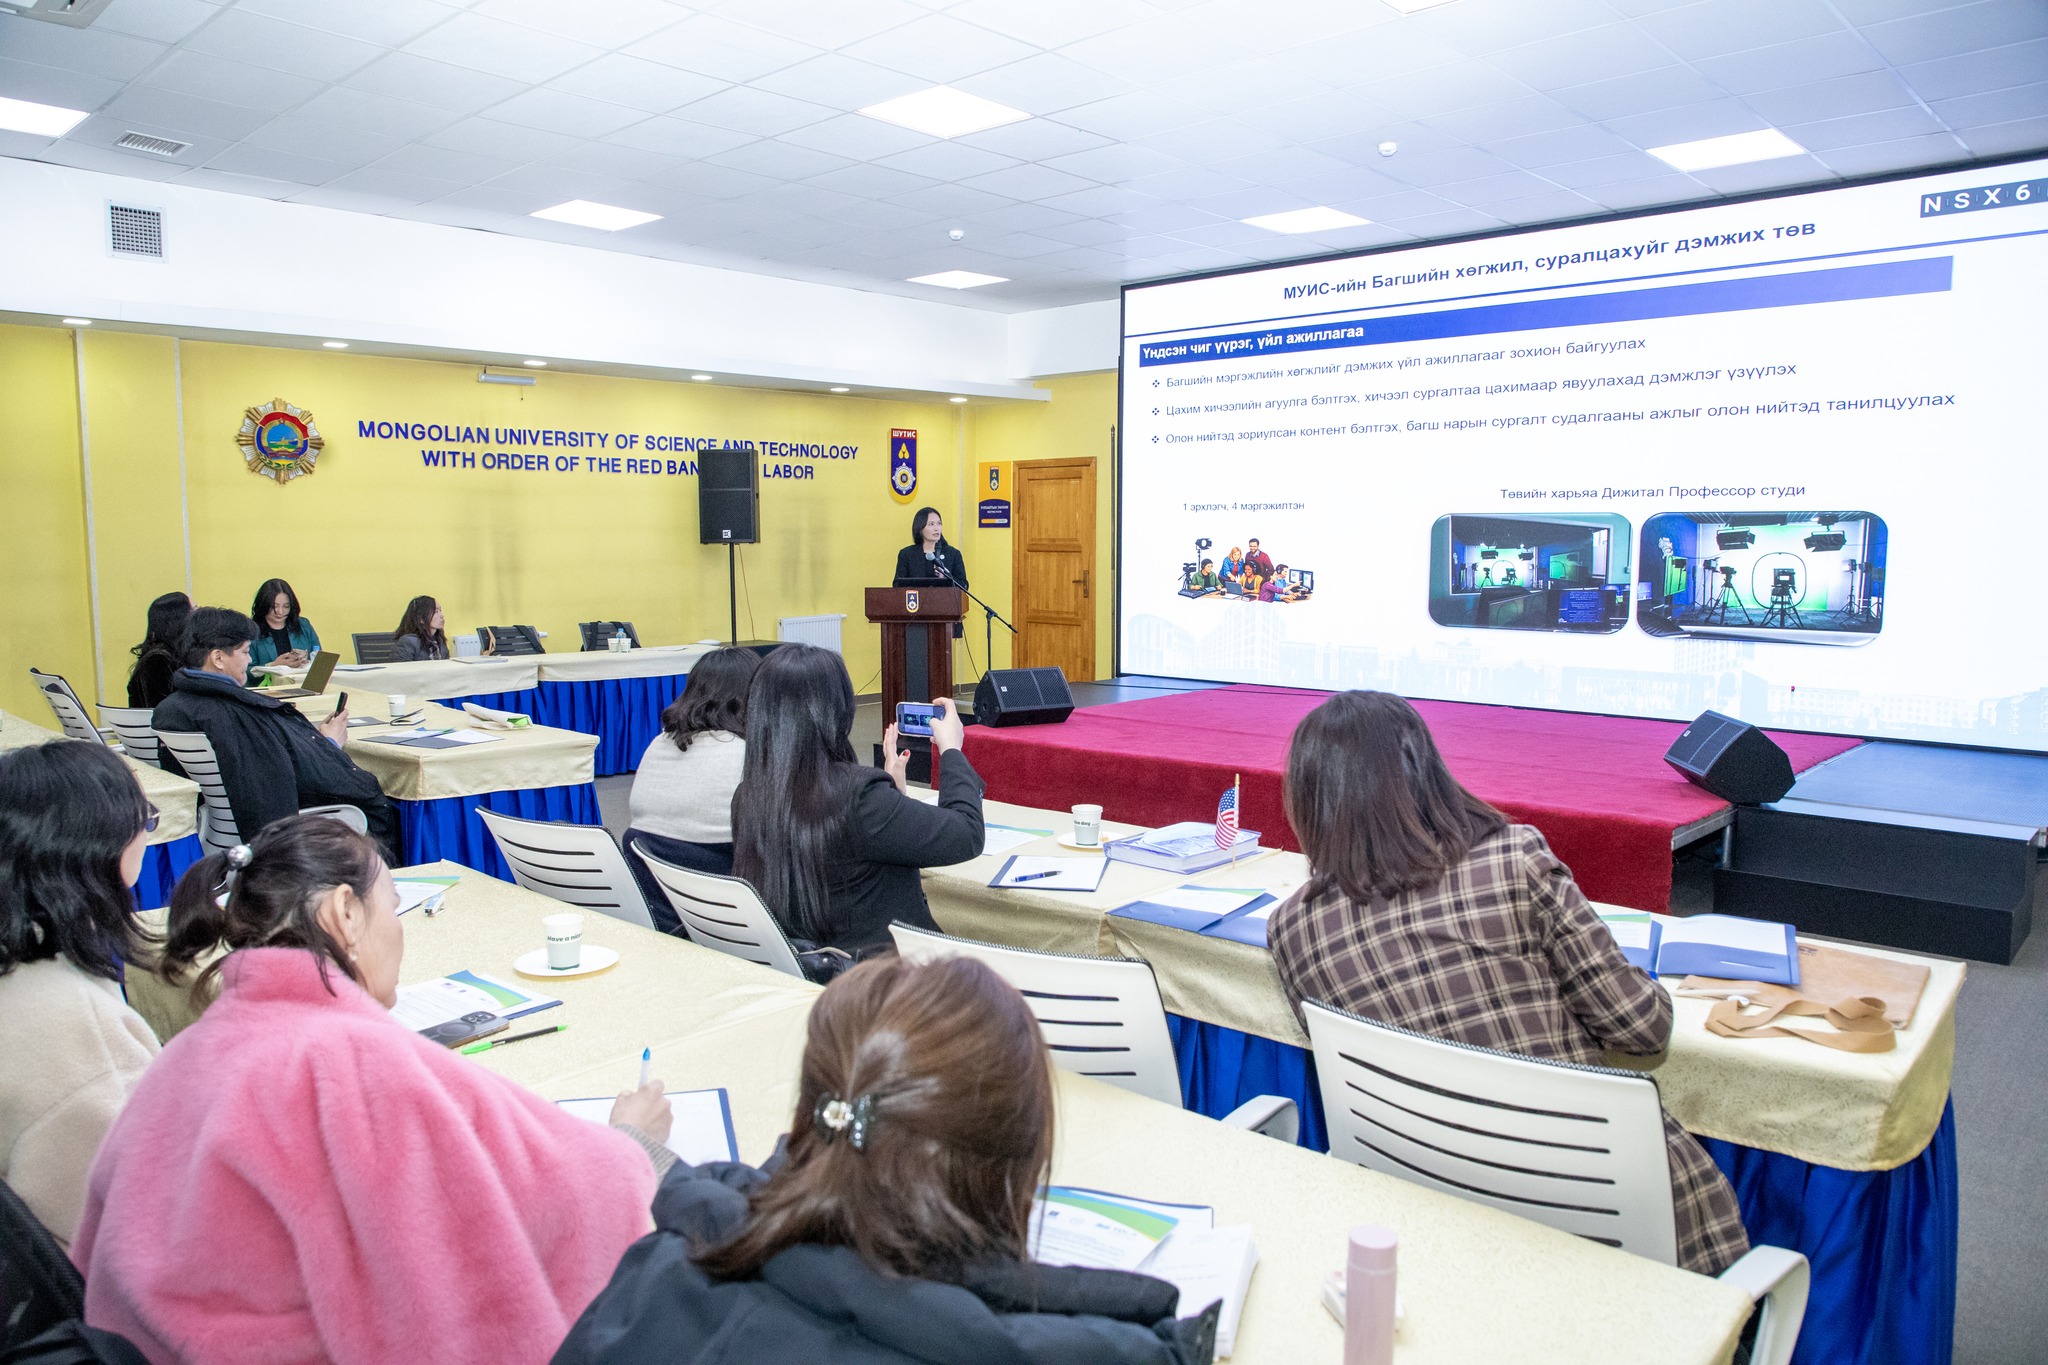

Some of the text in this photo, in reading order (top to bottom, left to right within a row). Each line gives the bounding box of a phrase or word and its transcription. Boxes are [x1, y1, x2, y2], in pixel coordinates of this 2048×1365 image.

[1283, 223, 1816, 300] МУИС-ийн Багшийн хөгжил, суралцахуйг дэмжих төв
[1142, 326, 1364, 359] Үндсэн чиг үүрэг, үйл ажиллагаа
[1166, 339, 1646, 388] Багшийн мэргэжлийн хөгжлийг дэмжих үйл ажиллагааг зохион байгуулах
[1166, 364, 1797, 417] Цахим хичээлийн агуулга бэлтгэх, хичээл сургалтаа цахимаар явуулахад дэмжлэг үзүүлэх
[358, 420, 859, 460] MONGOLIAN UNIVERSITY OF SCIENCE AND TECHNOLOGY
[1165, 394, 1955, 444] Олон нийтэд зориулсан контент бэлтгэх, багш нарын сургалт судалгааны ажлыг олон нийтэд танилцуулах
[421, 449, 815, 480] WITH ORDER OF THE RED BAN LABOR
[1500, 488, 1547, 499] Төвийн
[1601, 487, 1664, 500] Дижитал
[1669, 485, 1756, 500] Профессор
[1760, 486, 1806, 499] студи
